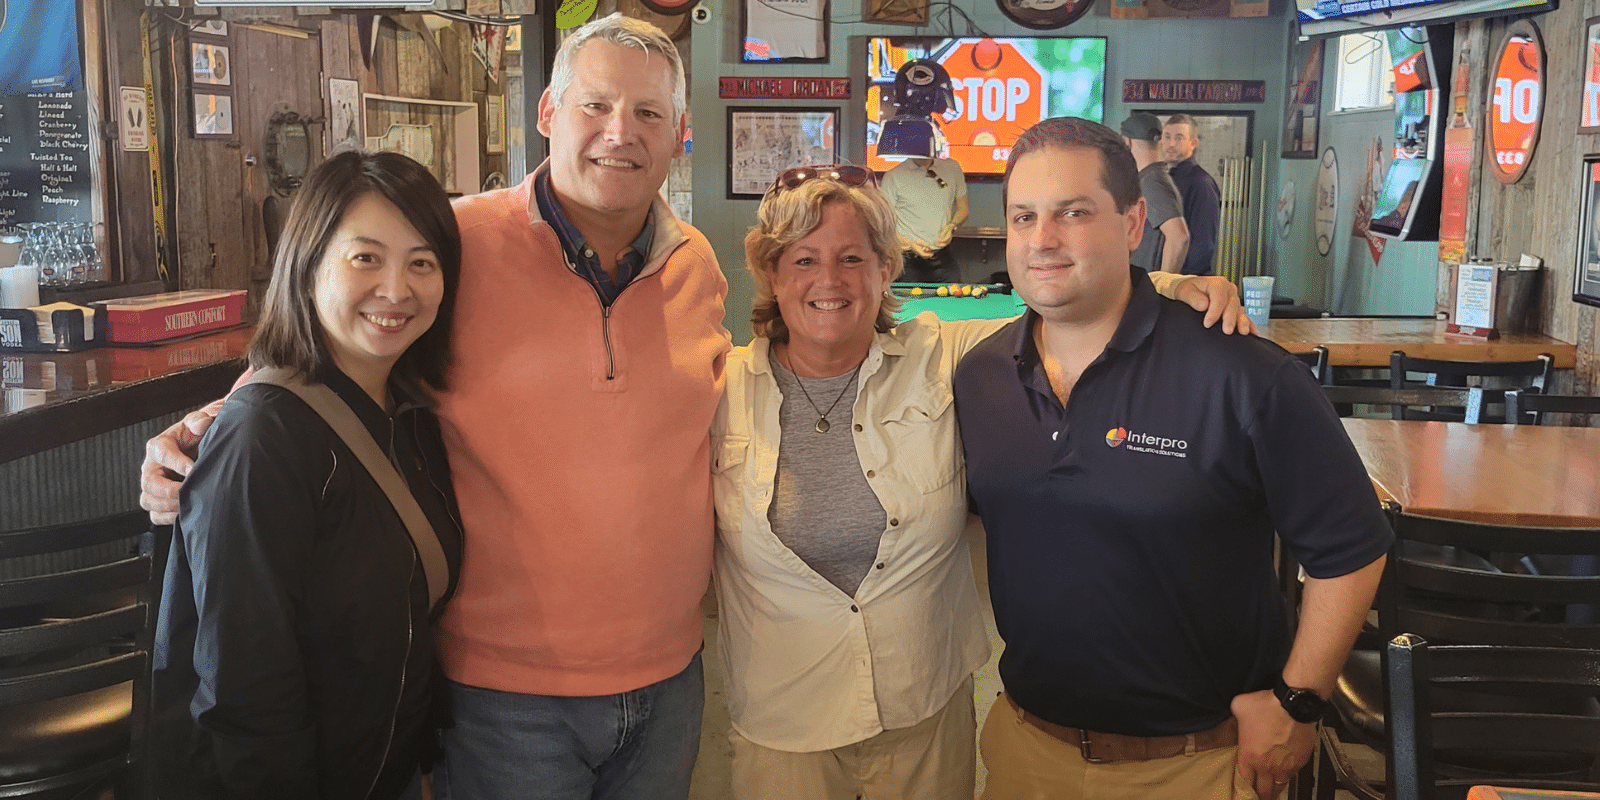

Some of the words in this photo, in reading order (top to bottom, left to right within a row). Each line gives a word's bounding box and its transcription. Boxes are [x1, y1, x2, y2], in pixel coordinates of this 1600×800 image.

[737, 80, 783, 97] MICHAEL
[788, 79, 835, 98] JORDAN
[1149, 82, 1195, 100] WALTER
[1197, 82, 1243, 100] PAYTON
[38, 101, 72, 110] Lemonade
[951, 77, 1031, 122] STOP
[39, 120, 77, 131] Cranberry
[40, 140, 61, 148] Black
[62, 140, 89, 151] Cherry
[30, 152, 58, 161] Twisted
[60, 153, 74, 162] Tea
[992, 149, 1011, 162] 83
[40, 163, 55, 172] Half
[62, 164, 78, 172] Half
[41, 173, 73, 186] Original
[42, 185, 64, 194] Peach
[42, 194, 80, 207] Raspberry
[165, 310, 198, 332] SOUTHERN
[198, 305, 226, 326] COMFORT
[0, 324, 22, 343] SON
[1127, 430, 1188, 450] Interpro
[1126, 444, 1159, 455] TRANSLATION
[1159, 449, 1187, 459] SOLUTIONS
